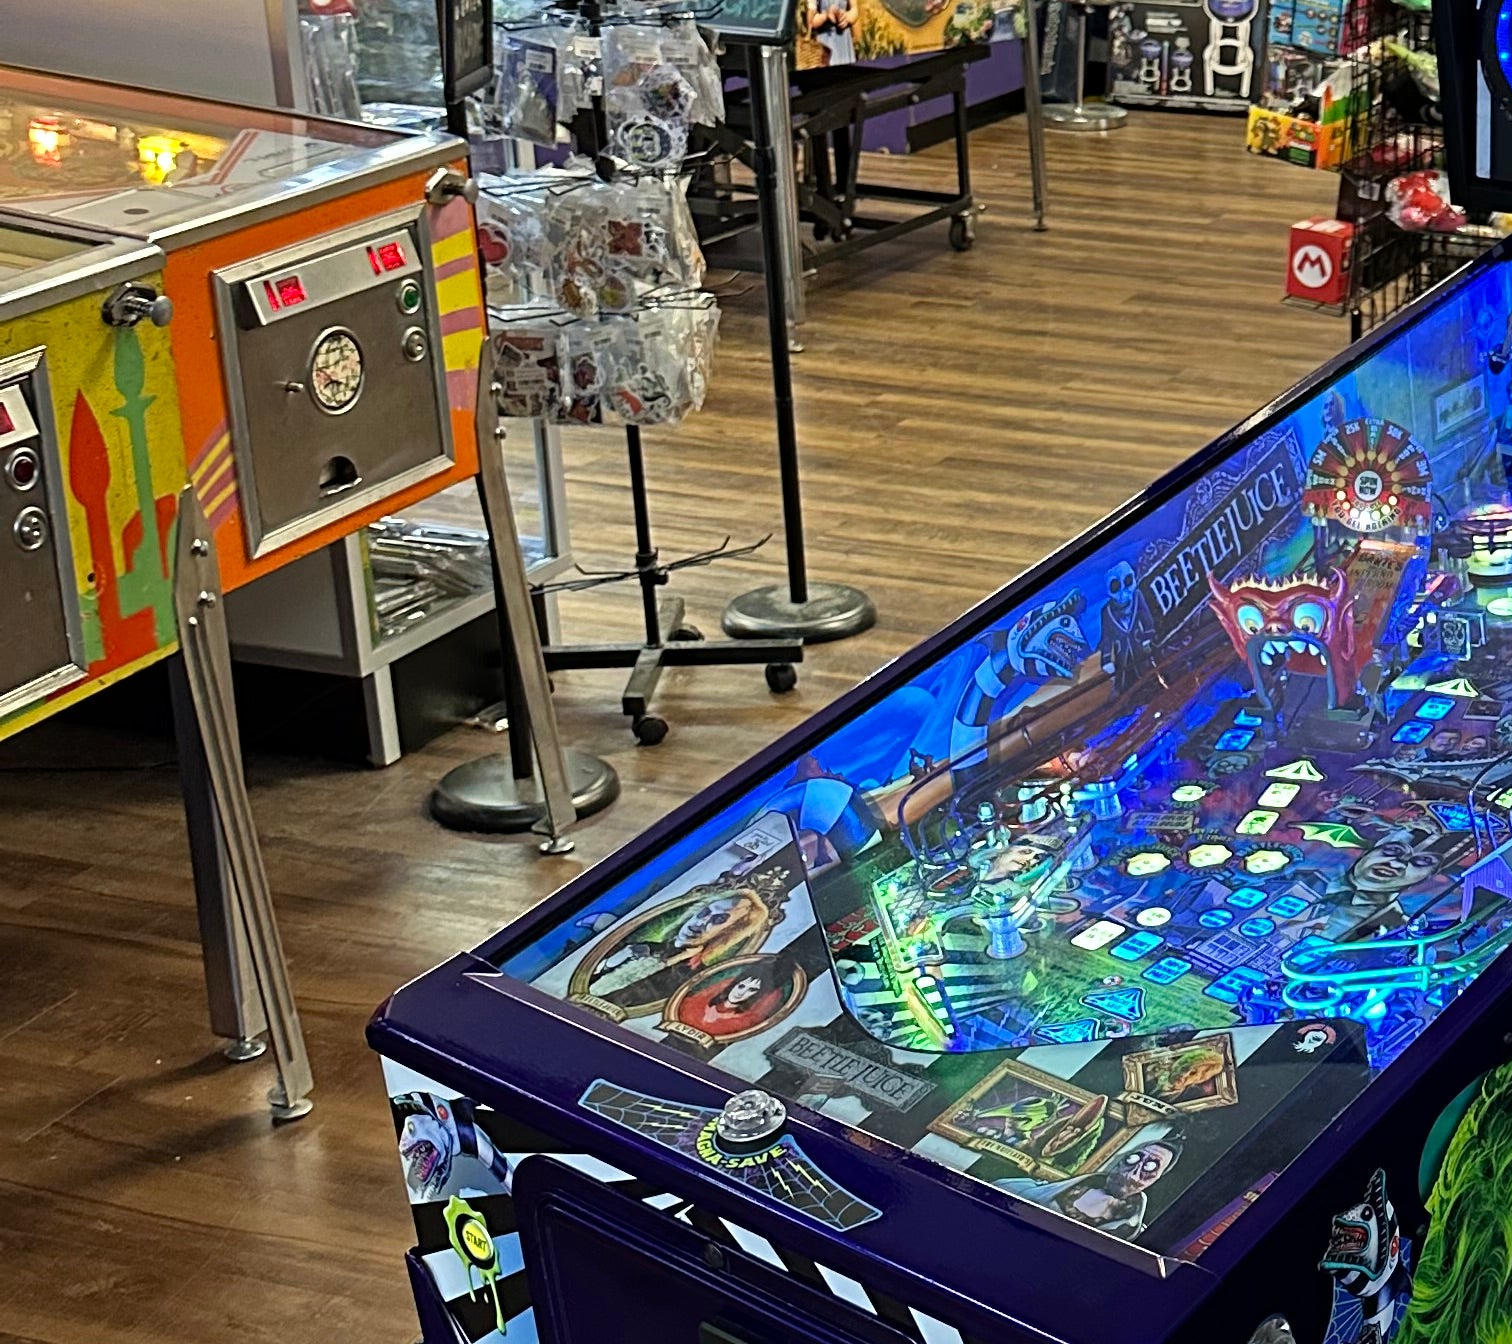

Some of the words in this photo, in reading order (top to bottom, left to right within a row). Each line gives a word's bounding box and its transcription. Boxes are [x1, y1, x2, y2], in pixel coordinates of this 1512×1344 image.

[1149, 462, 1292, 619] BEETLEJUICE
[675, 1022, 707, 1040] LYDIA
[789, 1035, 913, 1102] BEETLEJUICE
[696, 1119, 787, 1169] MAGNA-SAVE
[465, 1230, 487, 1253] START
